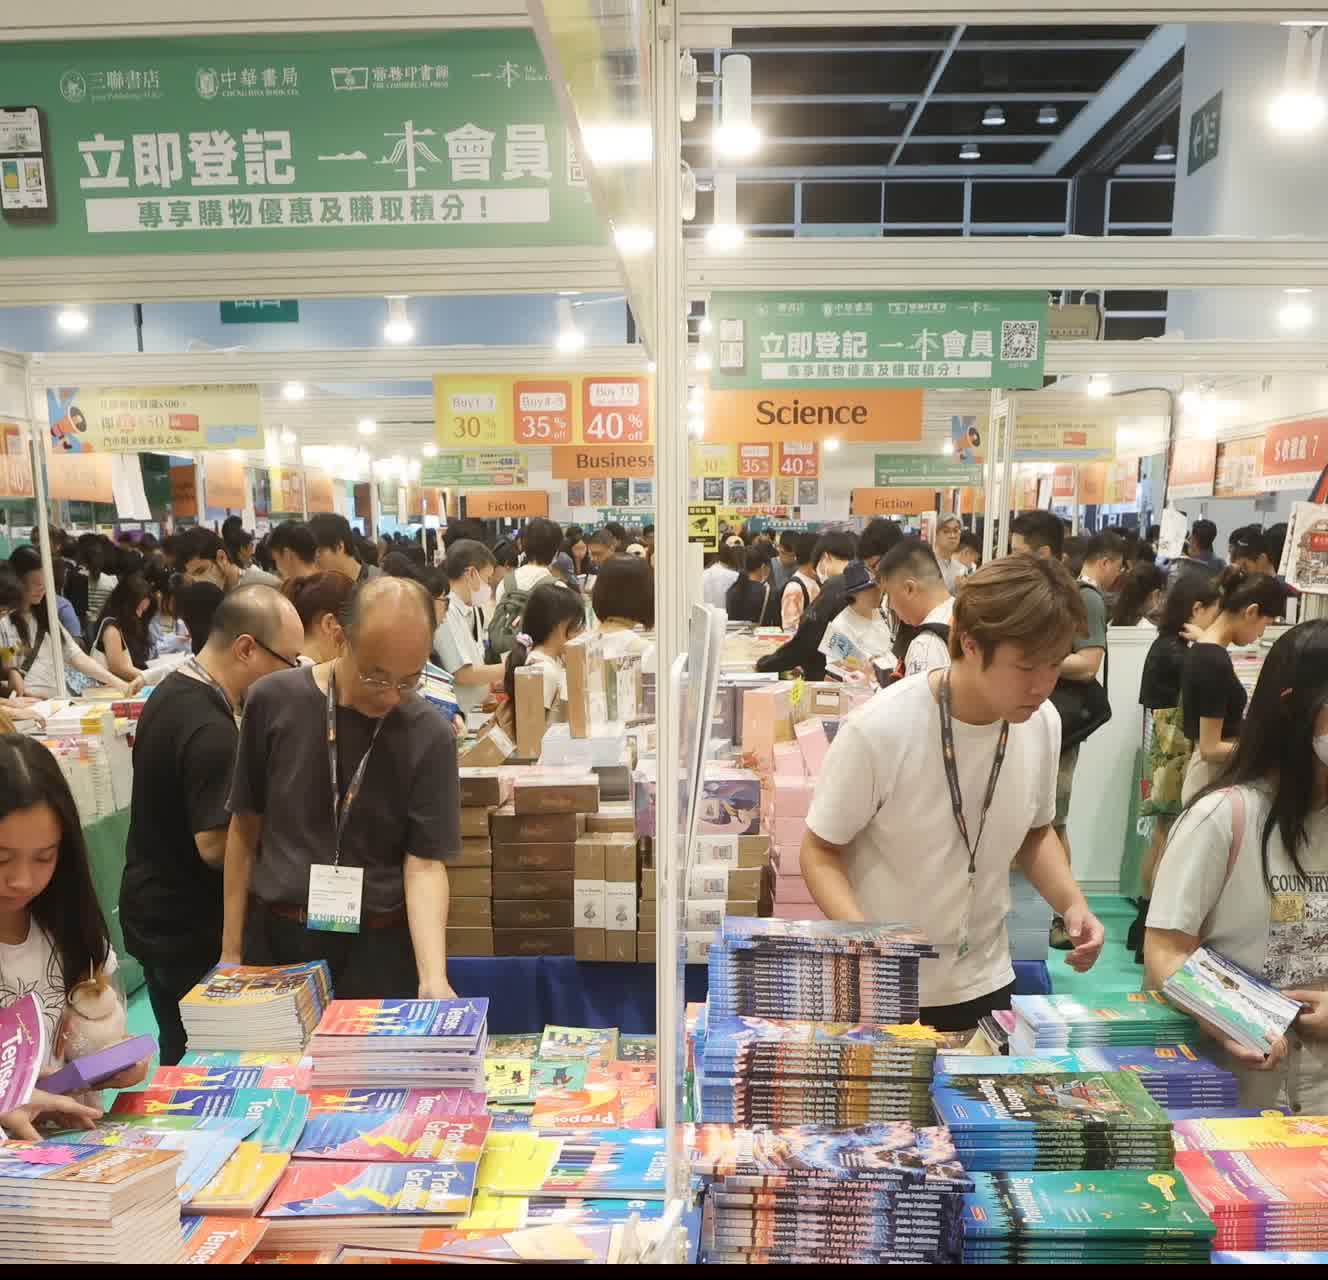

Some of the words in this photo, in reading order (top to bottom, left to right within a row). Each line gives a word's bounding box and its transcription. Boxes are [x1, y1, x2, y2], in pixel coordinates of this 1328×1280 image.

[221, 66, 298, 89] 中華書局
[78, 128, 296, 189] 立即登記
[318, 119, 553, 188] 一本會員
[760, 331, 868, 360] 立即登記
[755, 400, 868, 426] Science
[576, 453, 655, 471] Business
[487, 501, 527, 514] Fiction
[874, 498, 913, 510] Fiction
[186, 1229, 240, 1264] Tense
